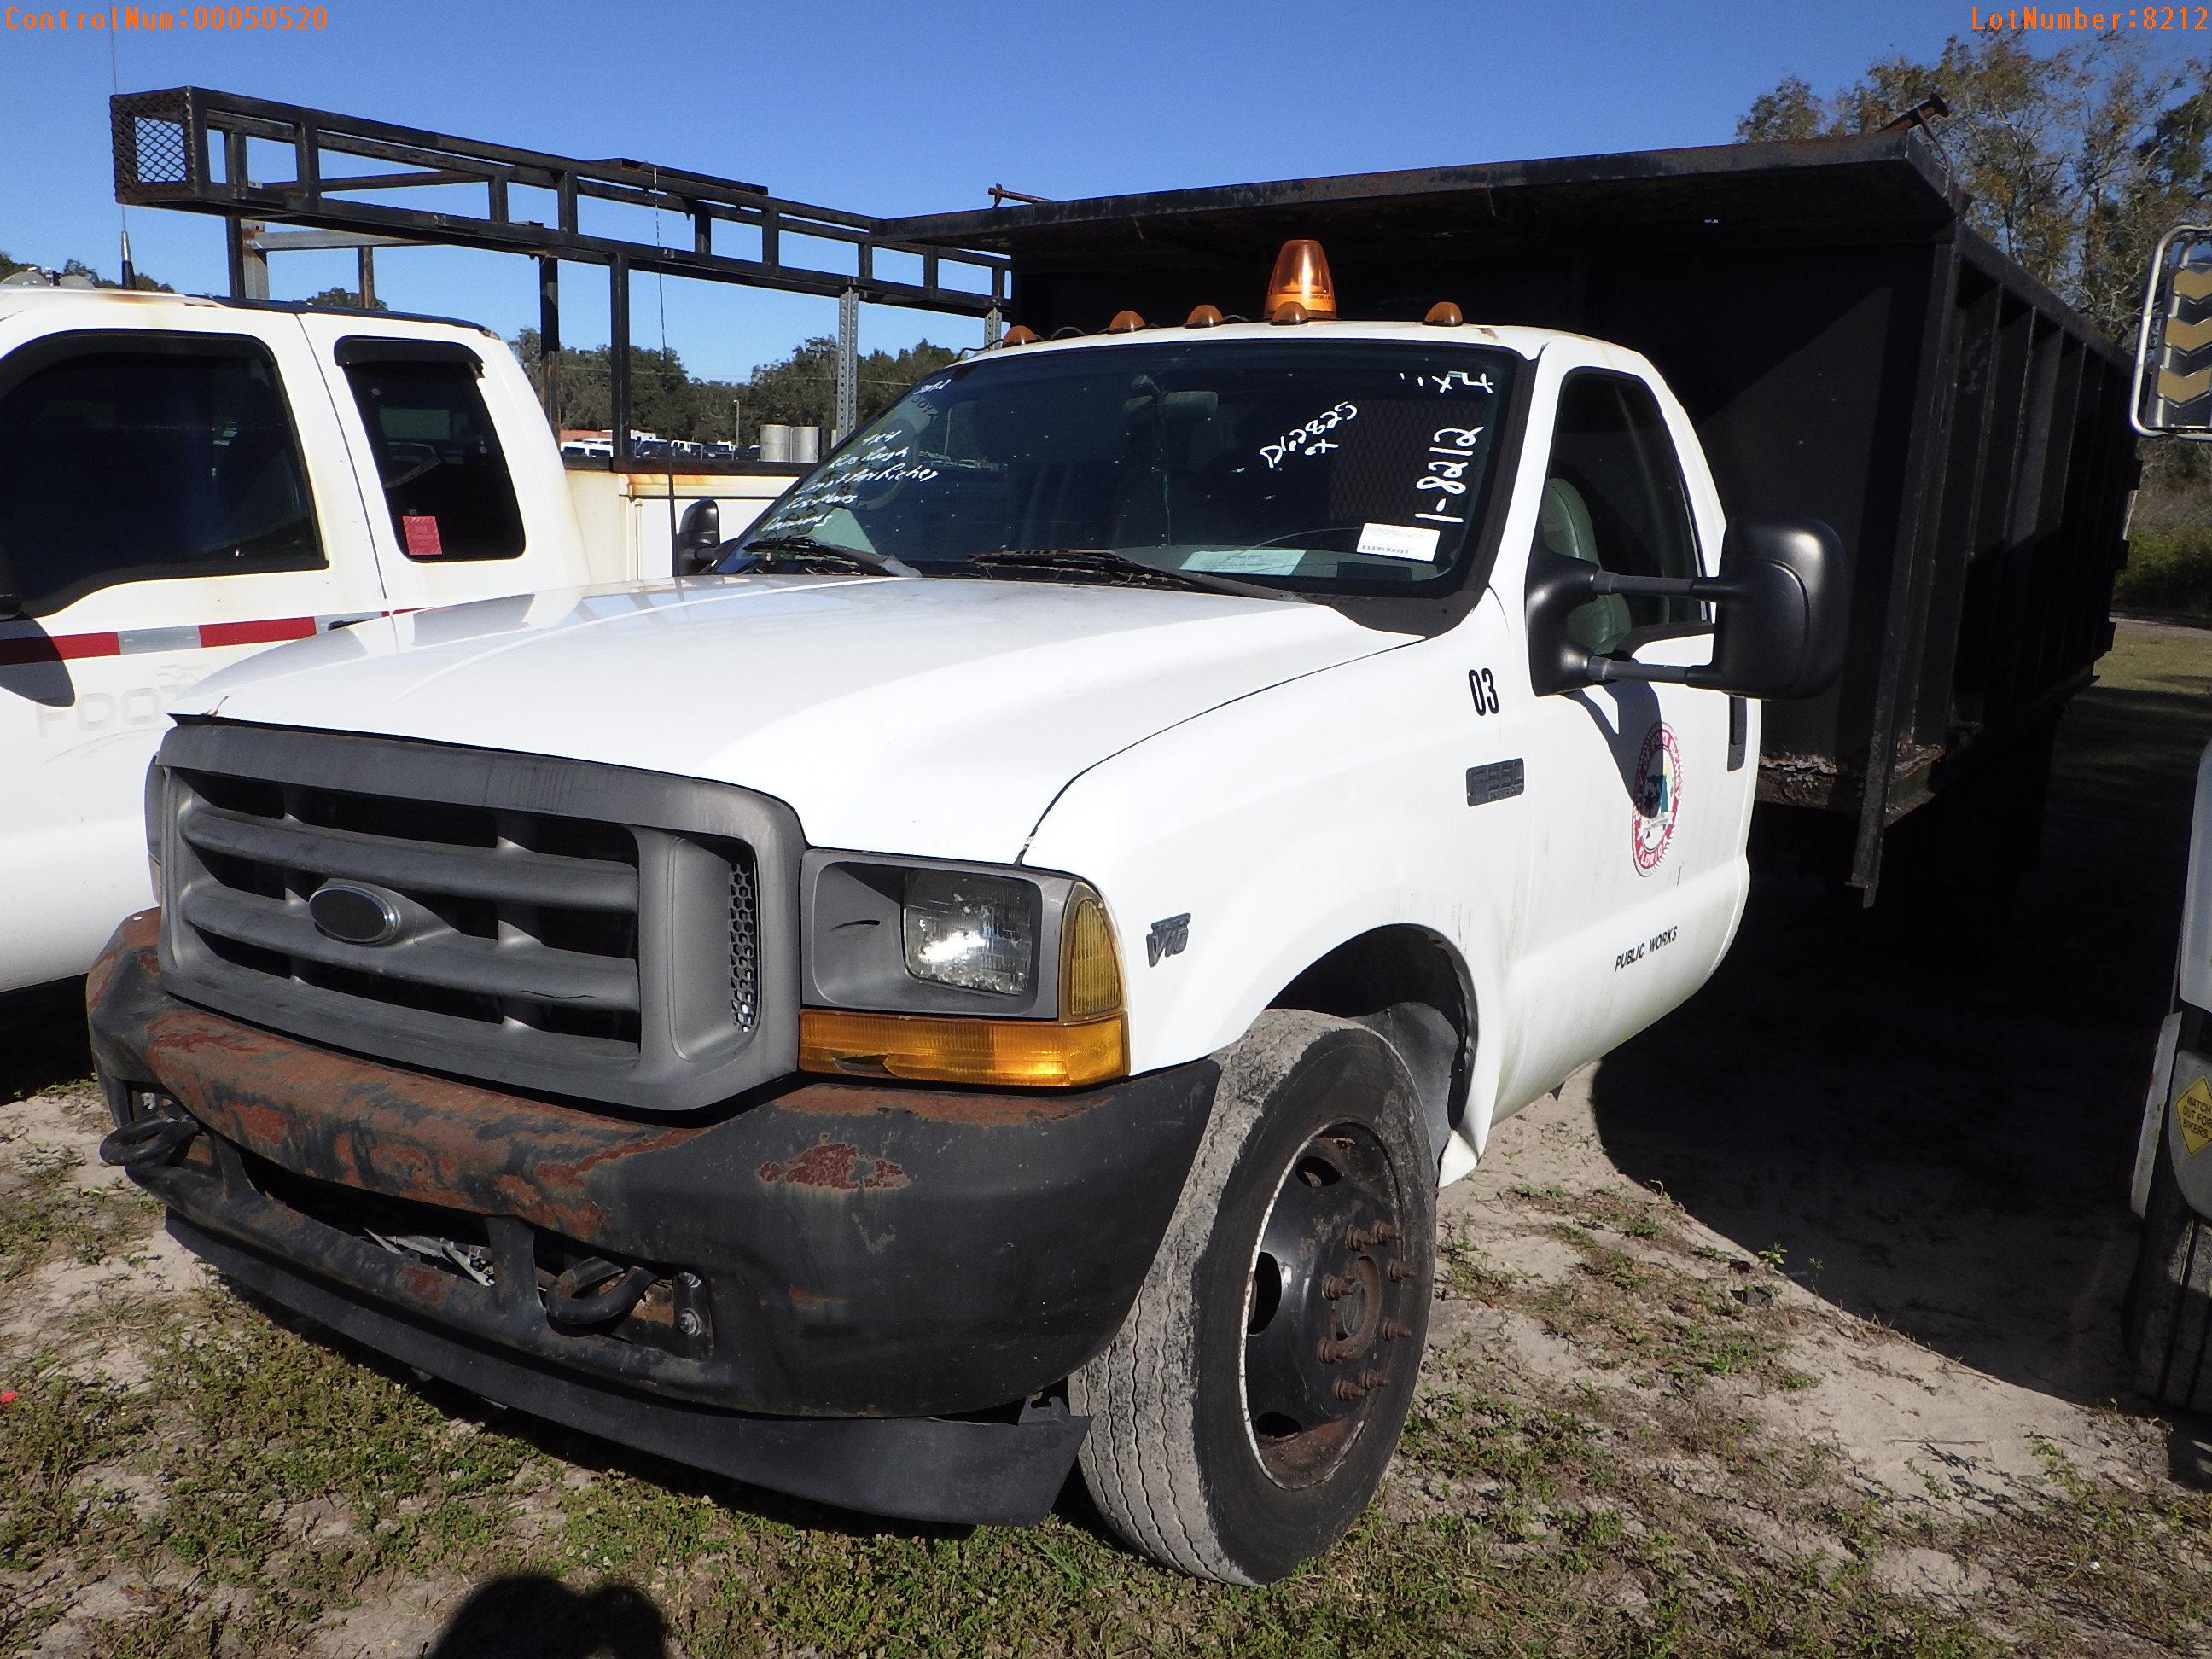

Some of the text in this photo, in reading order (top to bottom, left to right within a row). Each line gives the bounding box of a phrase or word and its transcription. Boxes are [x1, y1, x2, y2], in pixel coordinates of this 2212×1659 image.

[1414, 426, 1485, 523] 1-8212
[1468, 667, 1499, 717] 03
[1614, 925, 1678, 973] PUBLIC WORKS
[2183, 1106, 2212, 1128] OUT FOR
[2187, 1097, 2212, 1115] WATCH
